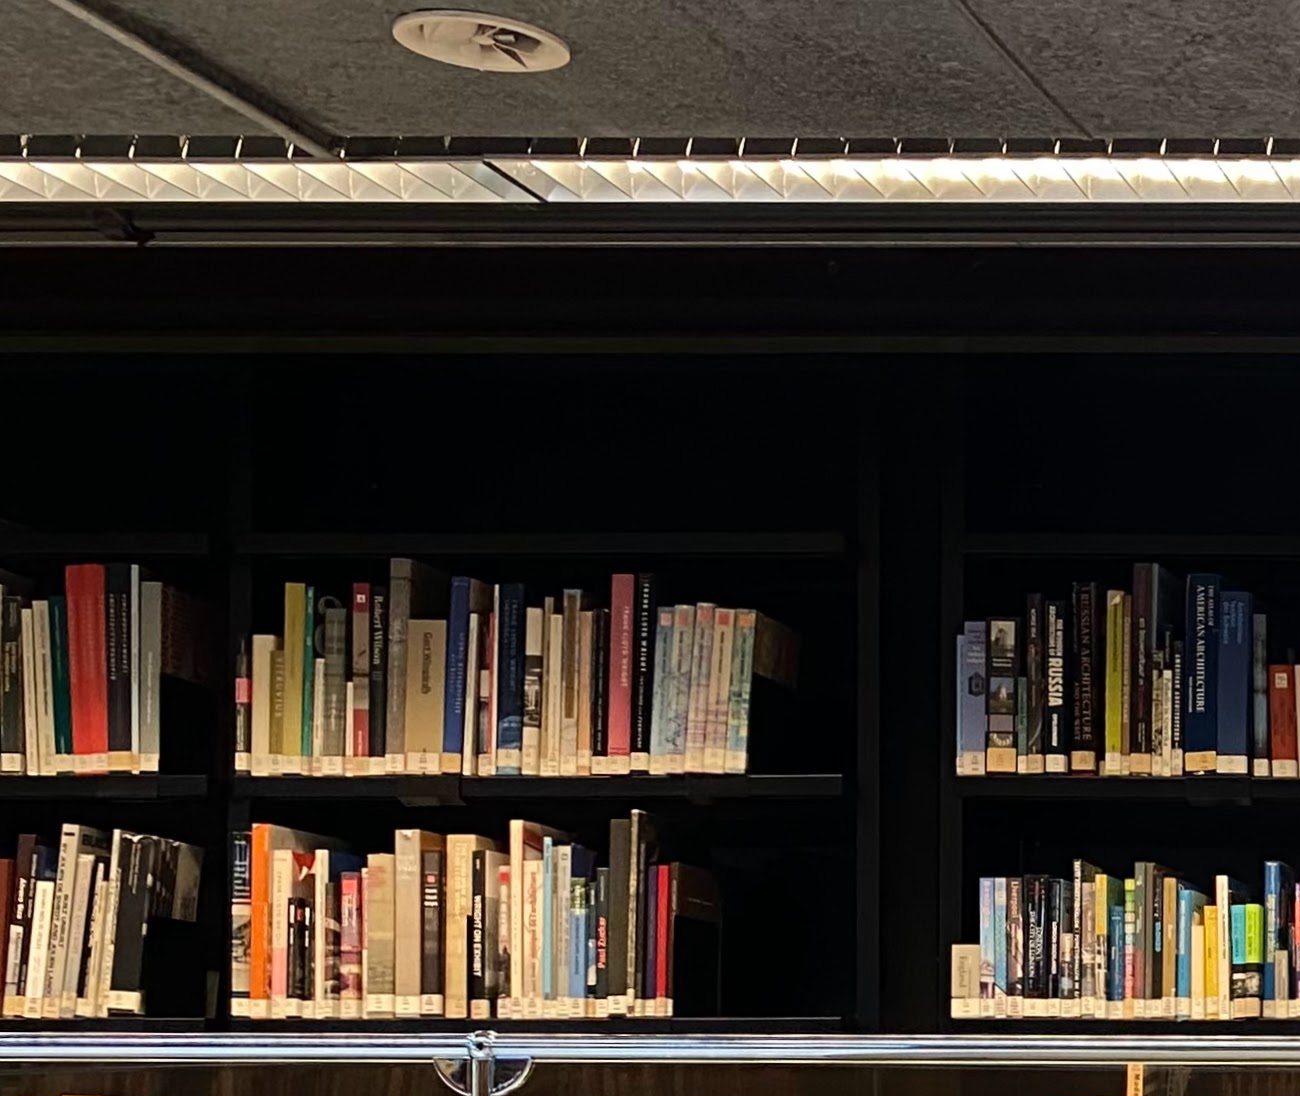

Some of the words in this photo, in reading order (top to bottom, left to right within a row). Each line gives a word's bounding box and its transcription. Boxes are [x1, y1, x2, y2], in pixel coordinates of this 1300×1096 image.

[373, 595, 384, 629] Robert
[640, 584, 650, 608] FRANK
[1196, 585, 1205, 637] AMERICAN
[640, 612, 650, 637] LLOYD
[1080, 593, 1092, 644] RUSSIAN
[373, 631, 384, 665] Wilson
[640, 640, 650, 672] WRIGHT
[1048, 657, 1064, 707] RUSSIA
[1196, 640, 1205, 713] ARCHITECTURE
[1080, 647, 1092, 741] ARCHITECTURE
[475, 895, 483, 928] WRIGHT
[1009, 881, 1020, 919] Liverpool
[475, 929, 483, 941] ON
[598, 917, 606, 947] Zucker
[475, 942, 483, 977] EXHIBIT
[598, 949, 606, 969] Paul
[960, 955, 968, 989] England
